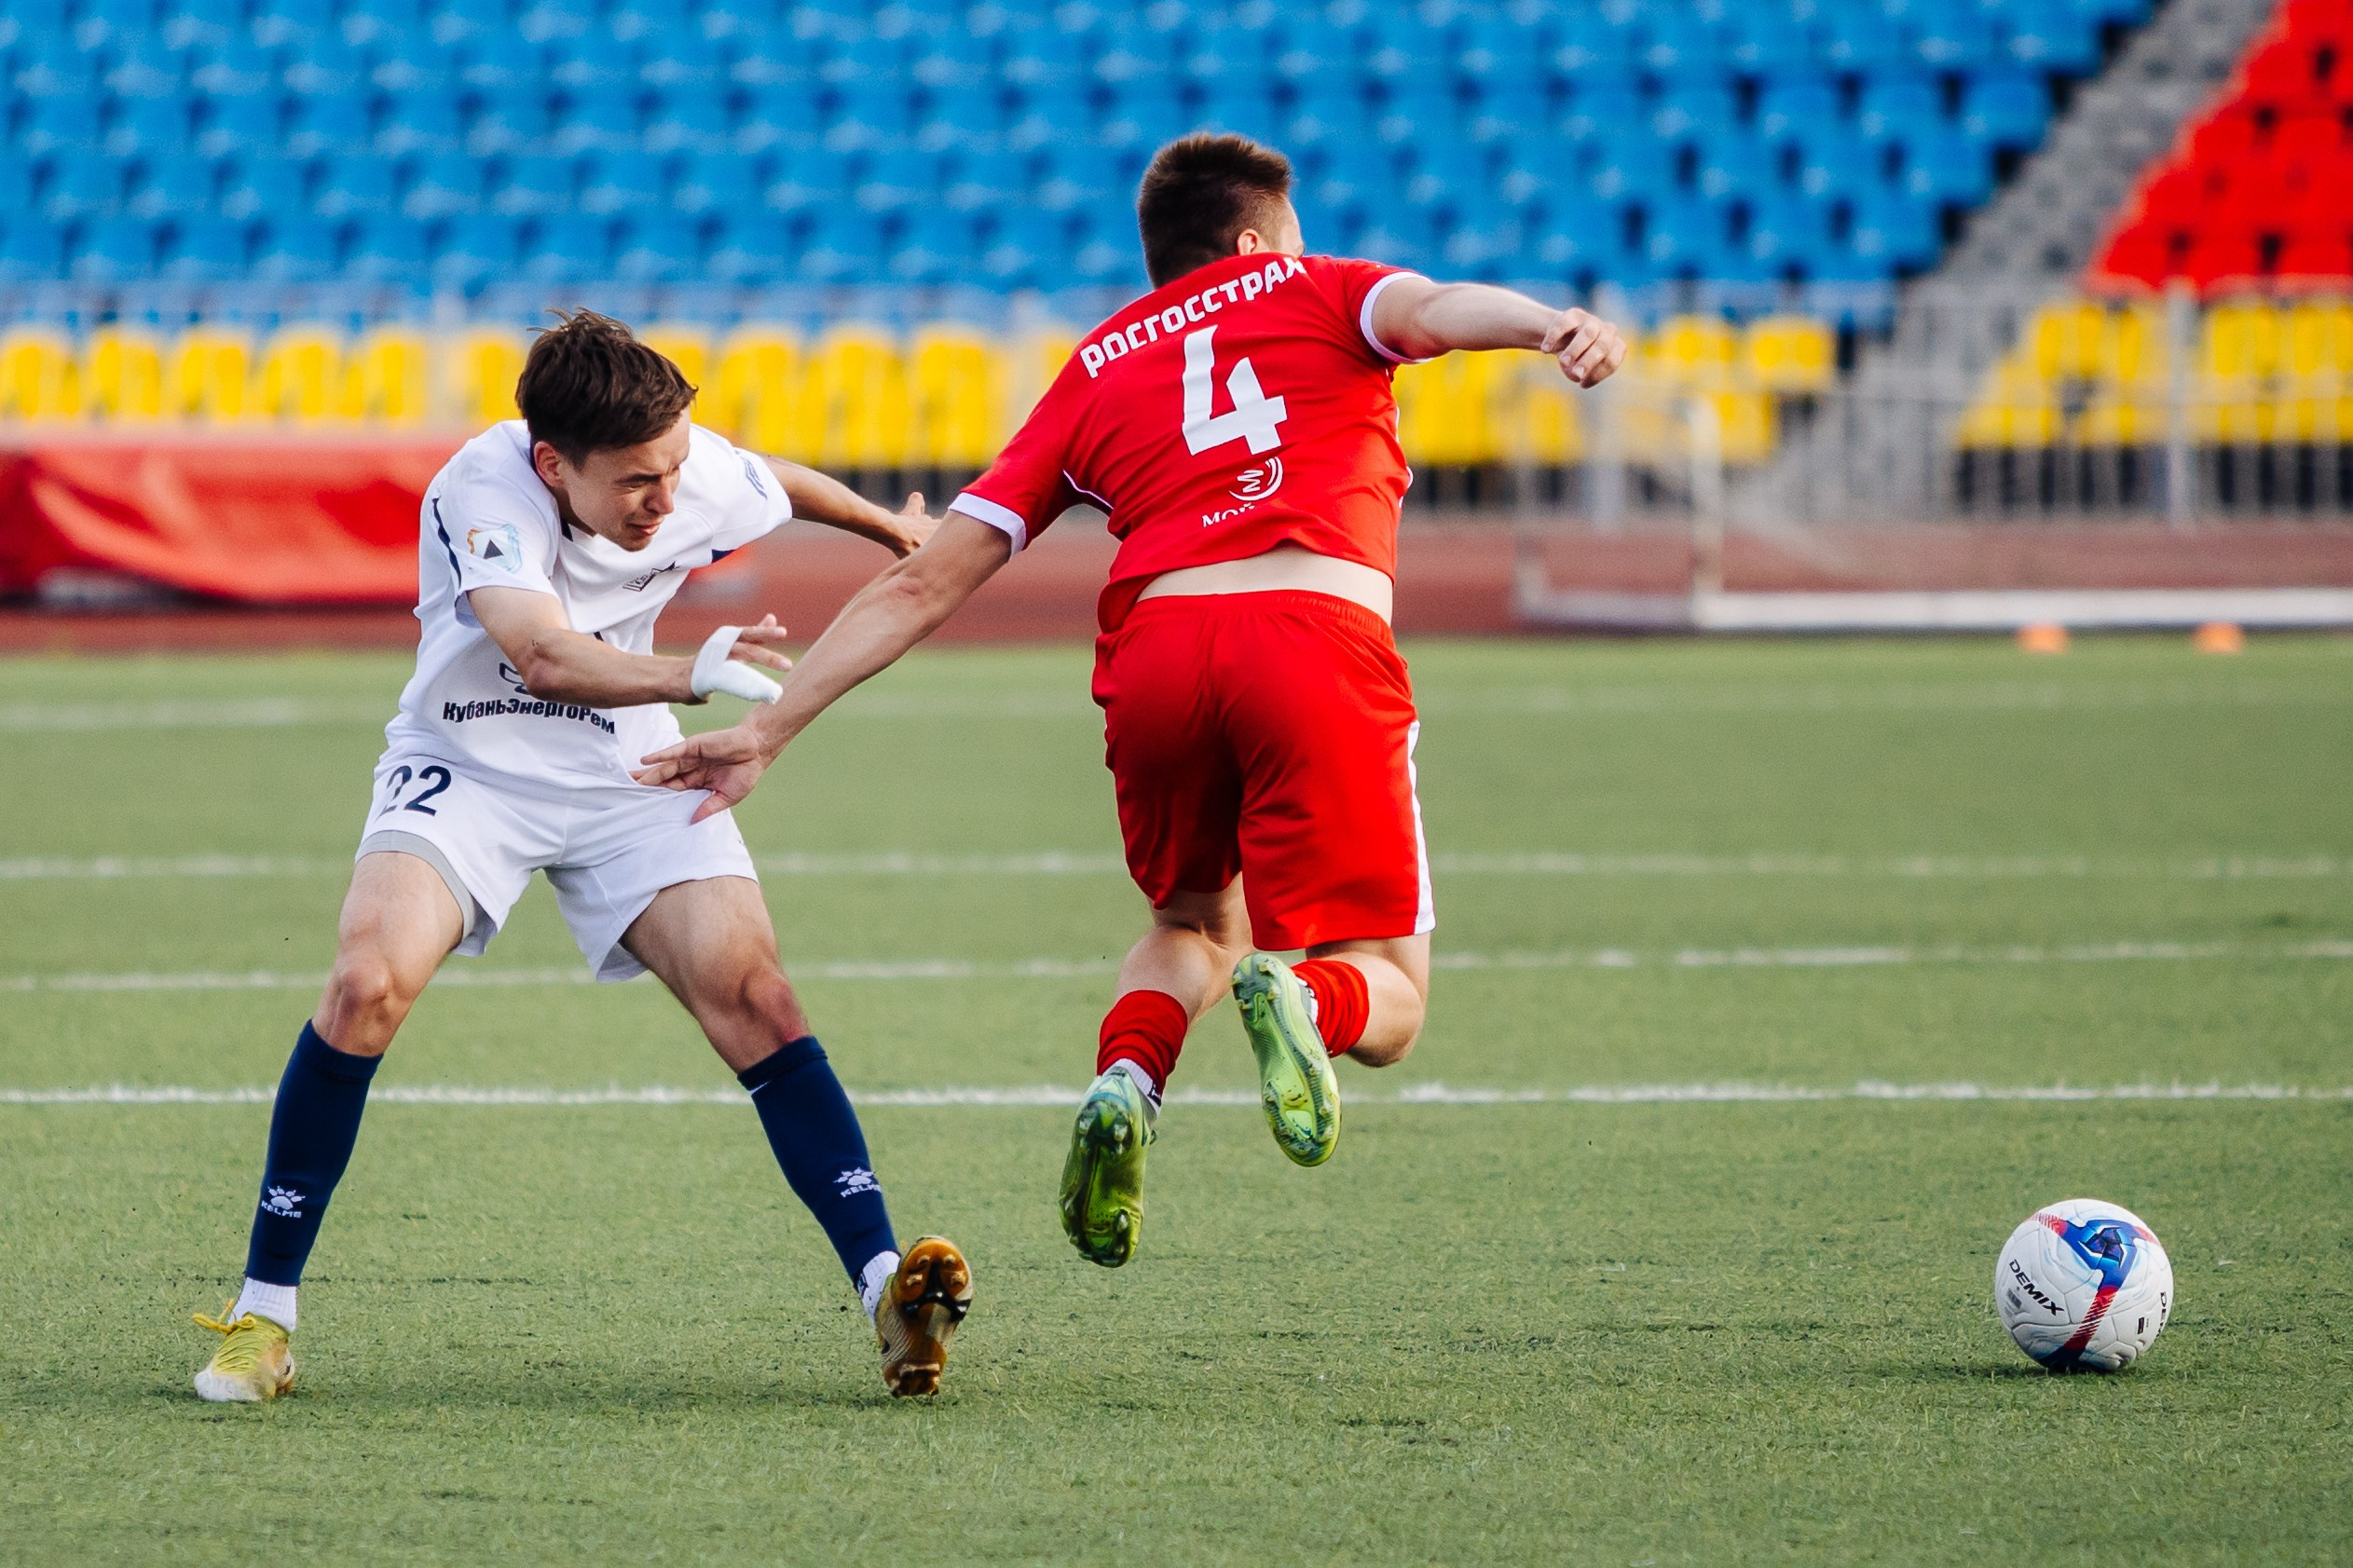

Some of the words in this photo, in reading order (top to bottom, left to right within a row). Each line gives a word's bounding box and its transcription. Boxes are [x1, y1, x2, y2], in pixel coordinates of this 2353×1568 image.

[1079, 257, 1307, 379] РОСГОССТРАХ
[1182, 324, 1288, 456] 4
[375, 765, 452, 821] 22
[261, 1199, 302, 1218] KELME
[2009, 1259, 2065, 1316] DEMIX
